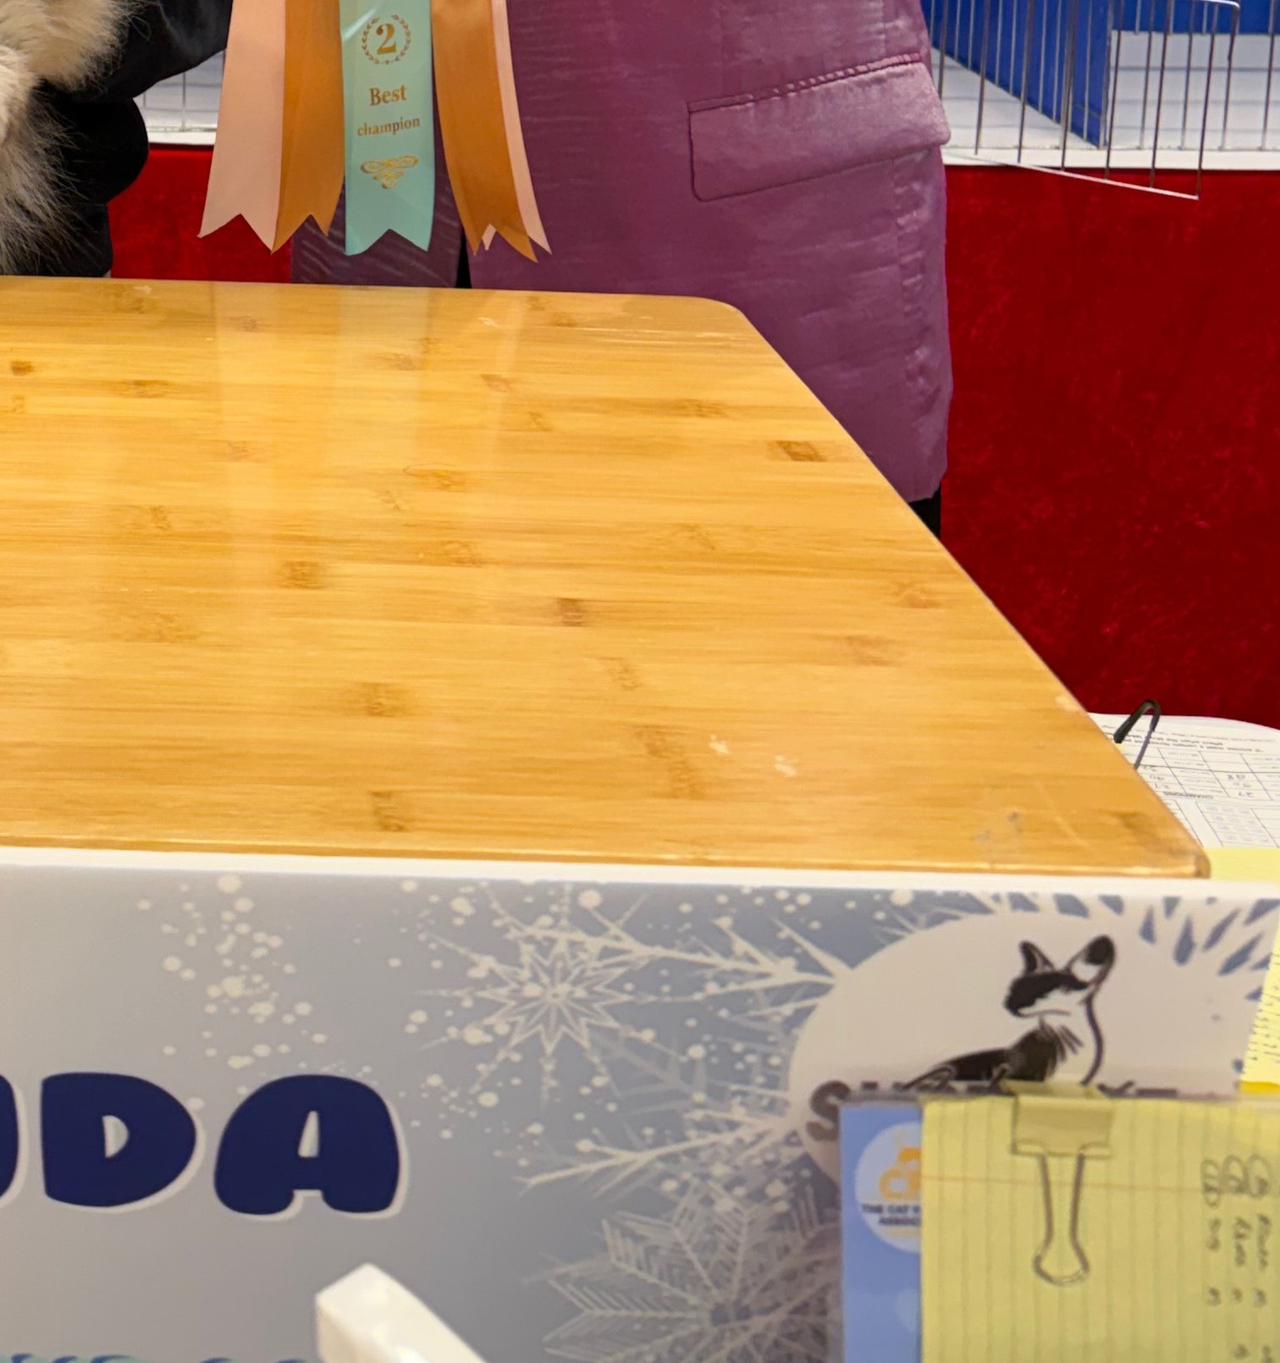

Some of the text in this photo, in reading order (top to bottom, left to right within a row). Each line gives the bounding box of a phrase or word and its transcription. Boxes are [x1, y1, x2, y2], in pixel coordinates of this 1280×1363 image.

[376, 23, 397, 55] 2
[369, 85, 407, 106] Best
[357, 117, 421, 136] champion
